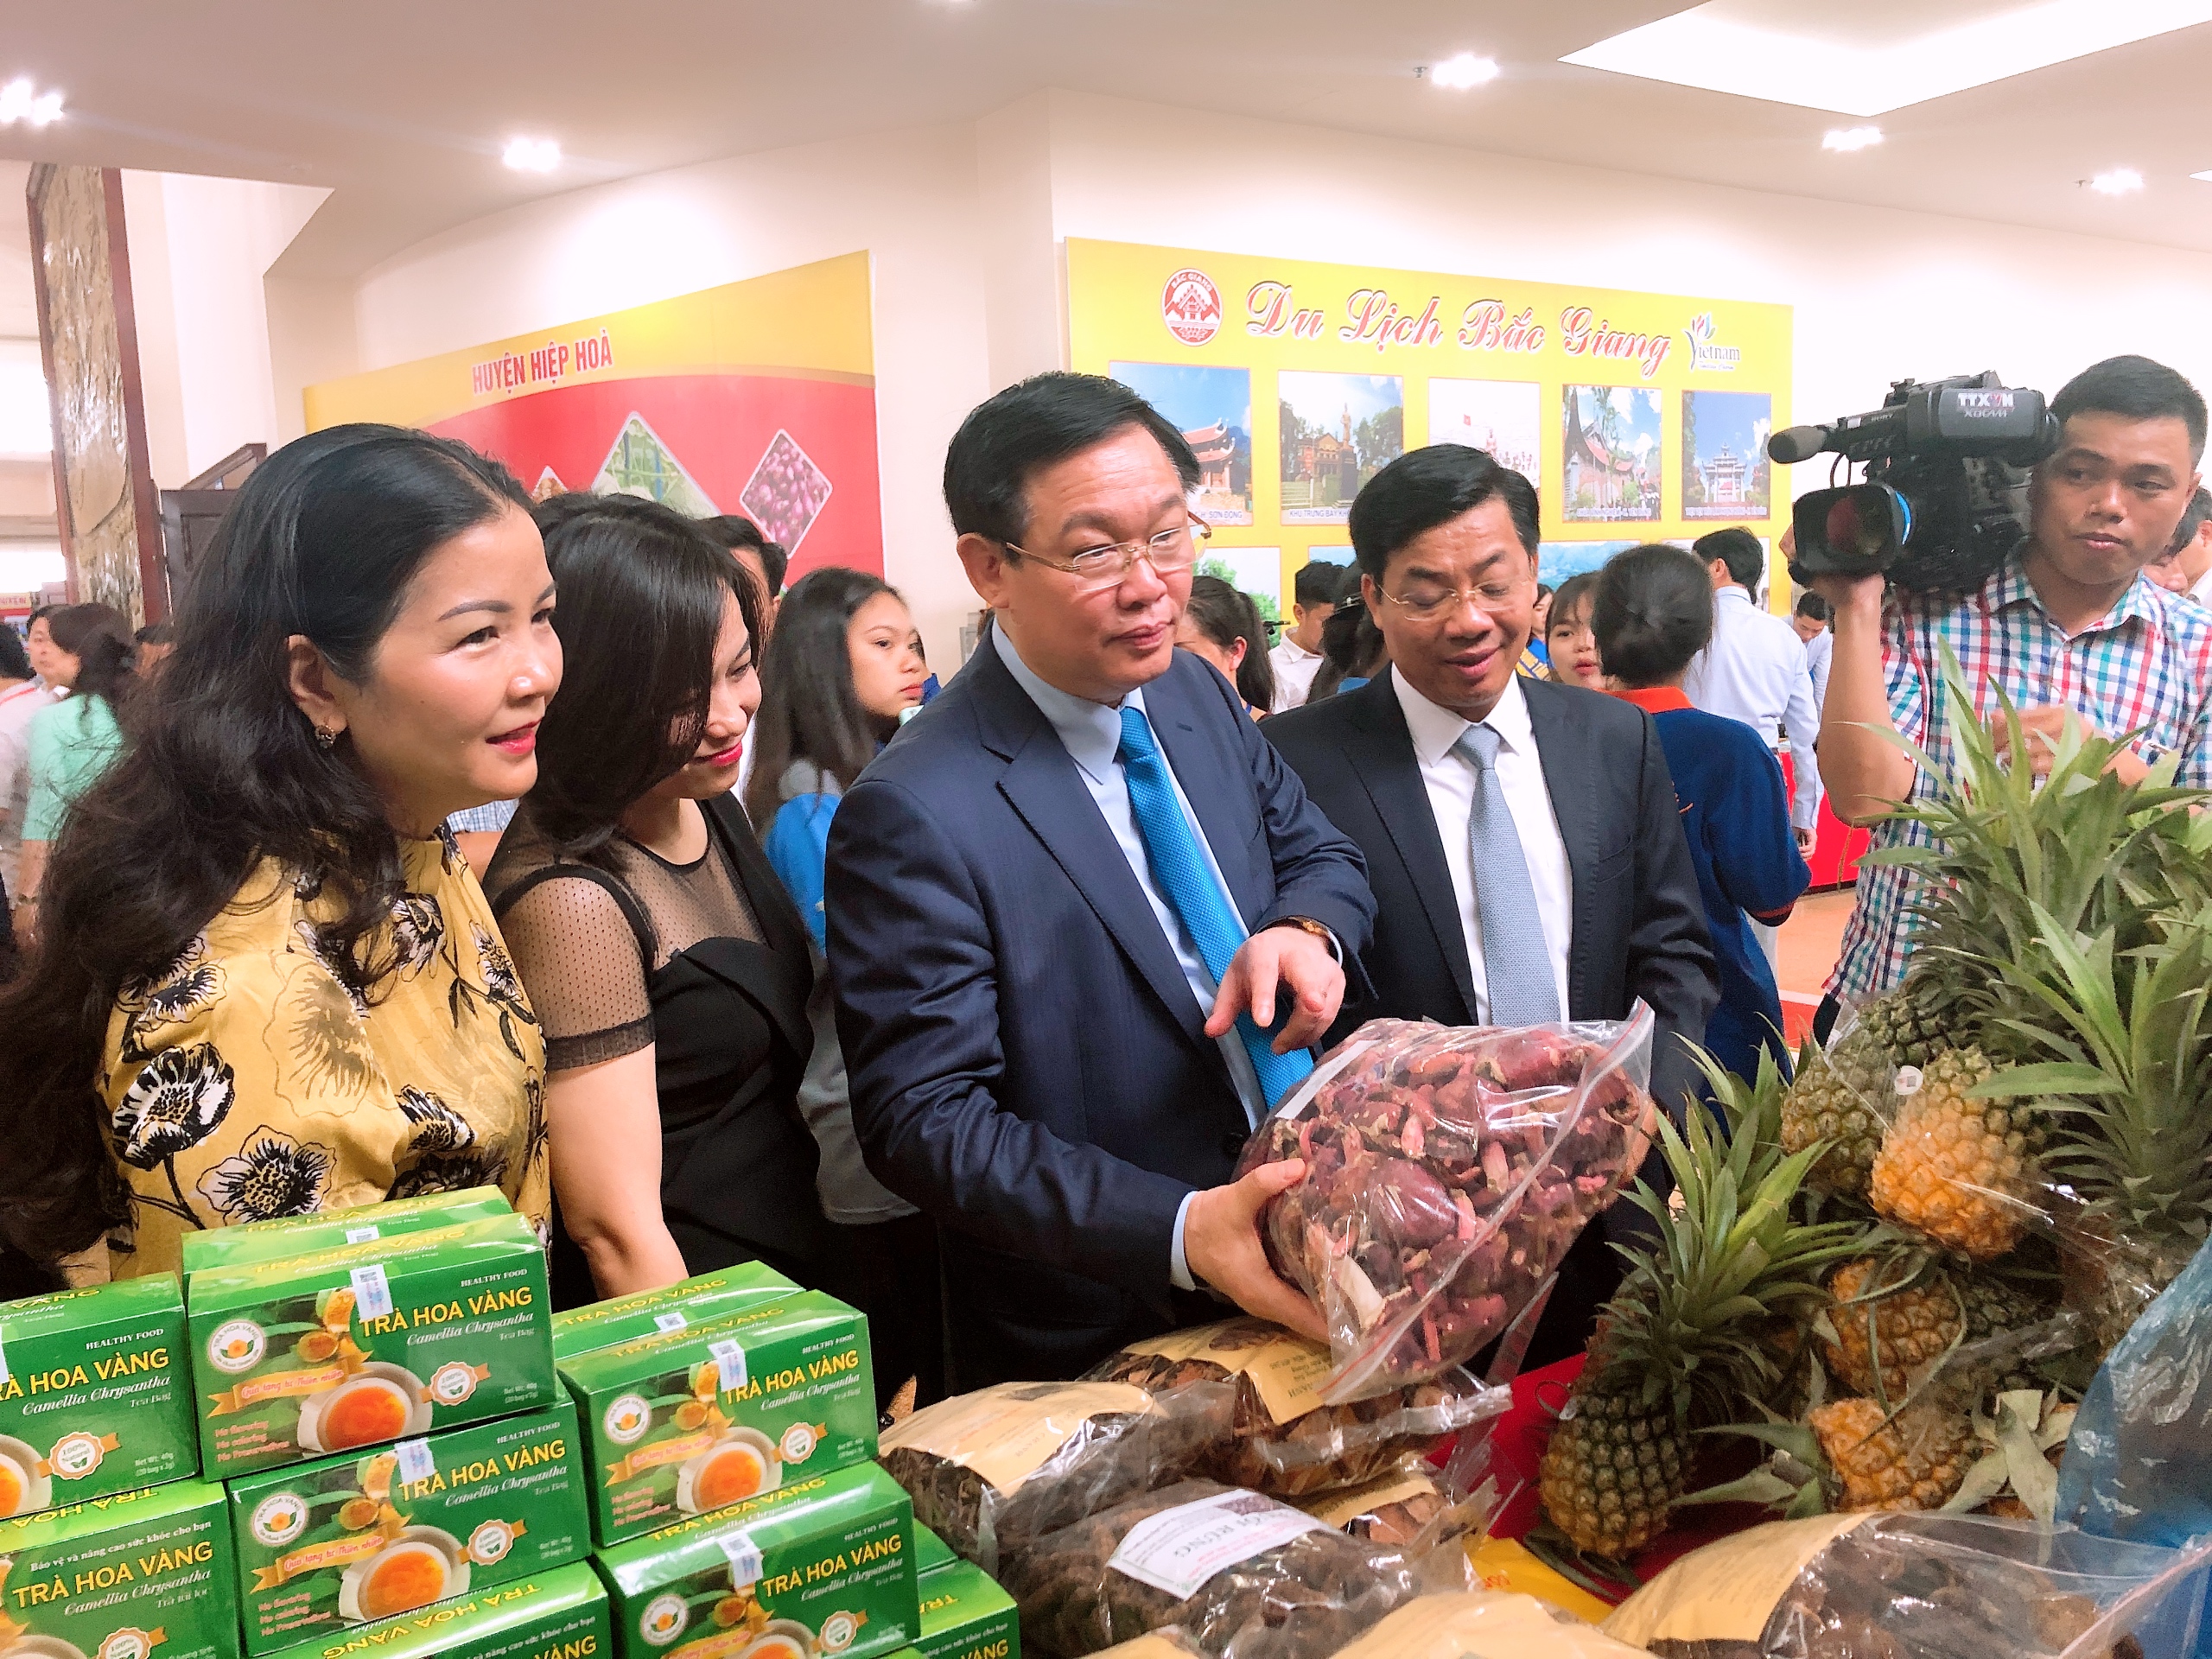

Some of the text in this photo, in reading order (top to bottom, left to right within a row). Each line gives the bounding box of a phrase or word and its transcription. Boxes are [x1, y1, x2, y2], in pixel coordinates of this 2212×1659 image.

[1246, 280, 1672, 378] Du Lịch Bắc Giang
[472, 351, 526, 395] HUYỆN
[531, 340, 570, 385] HIỆP
[1684, 330, 1740, 370] Vietnam
[460, 1268, 528, 1287] HEALTHY FOOD
[0, 1302, 66, 1322] ysantha
[413, 1300, 464, 1328] HOA
[467, 1286, 533, 1316] VÀNG
[86, 1327, 165, 1351] HEALTHY FOOD
[406, 1311, 534, 1347] Camellia Chrysantha
[29, 1364, 90, 1395] HOA
[93, 1347, 170, 1381] VÀNG
[765, 1366, 806, 1394] HOA
[808, 1349, 860, 1380] VÀNG
[22, 1375, 172, 1416] Camellia Chrysantha
[130, 1397, 149, 1408] Tea
[760, 1373, 861, 1411] Camellia Chrysantha
[496, 1421, 561, 1445] HEALTHY FOOD
[450, 1457, 501, 1488] HOA
[504, 1439, 566, 1471] VÀNG
[445, 1465, 568, 1508] Camellia Chrysantha
[702, 1501, 758, 1524] HOA
[108, 1542, 126, 1554] cao
[173, 1525, 192, 1537] cho
[193, 1520, 212, 1534] bạn
[12, 1541, 214, 1608] TRÀ HOA VÀNG
[762, 1566, 804, 1597] TRÀ
[805, 1554, 848, 1583] HOA
[850, 1534, 903, 1567] VÀNG
[64, 1568, 213, 1617] Camellia Chrysantha
